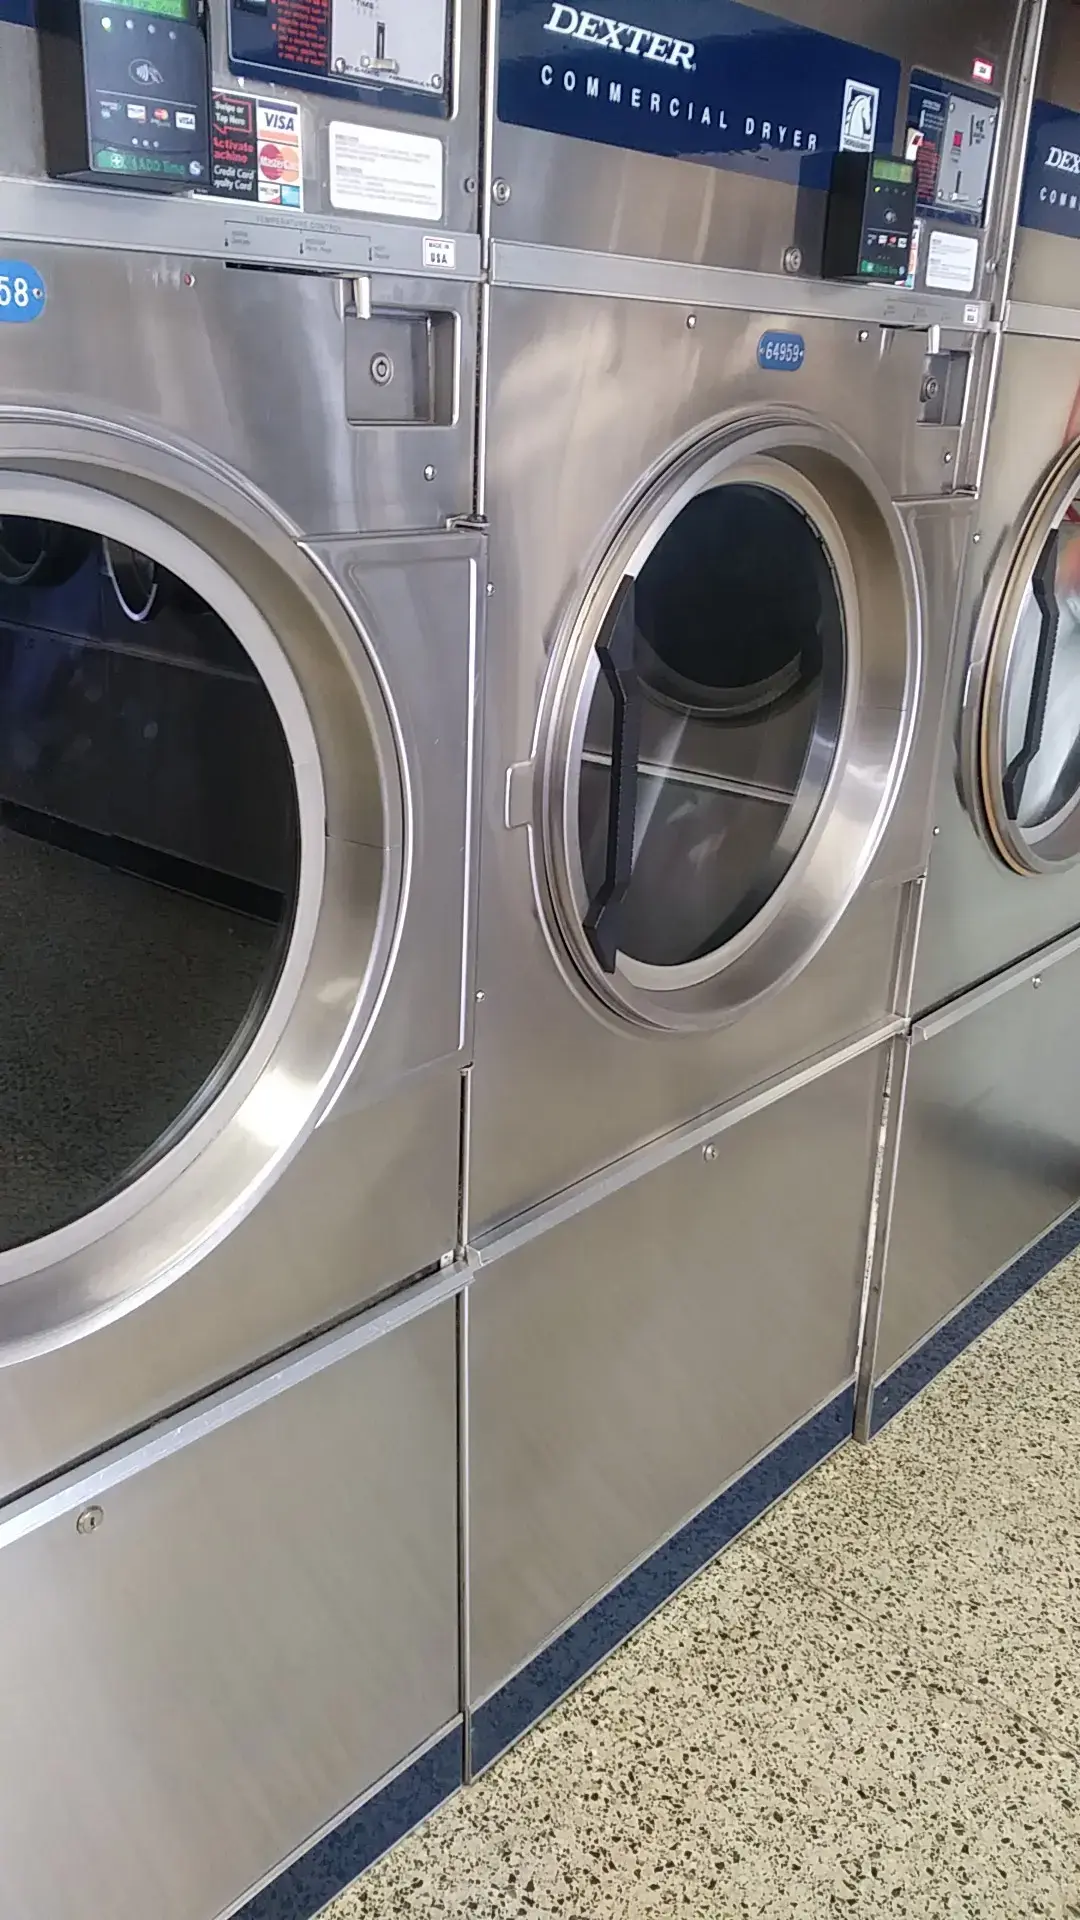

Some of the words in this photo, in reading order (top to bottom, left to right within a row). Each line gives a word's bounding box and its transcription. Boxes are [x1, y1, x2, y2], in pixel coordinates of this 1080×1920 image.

[543, 2, 696, 71] DEXTER
[215, 100, 236, 113] Swipe
[236, 106, 245, 114] or
[541, 65, 728, 129] COMMERCIAL
[745, 117, 817, 151] DRYER
[215, 112, 229, 124] Tap
[229, 114, 246, 126] Here
[264, 112, 294, 131] VISA
[214, 164, 236, 177] Credit
[236, 168, 255, 180] Card
[234, 179, 253, 191] Card
[430, 251, 448, 264] USA
[765, 341, 800, 363] 64959
